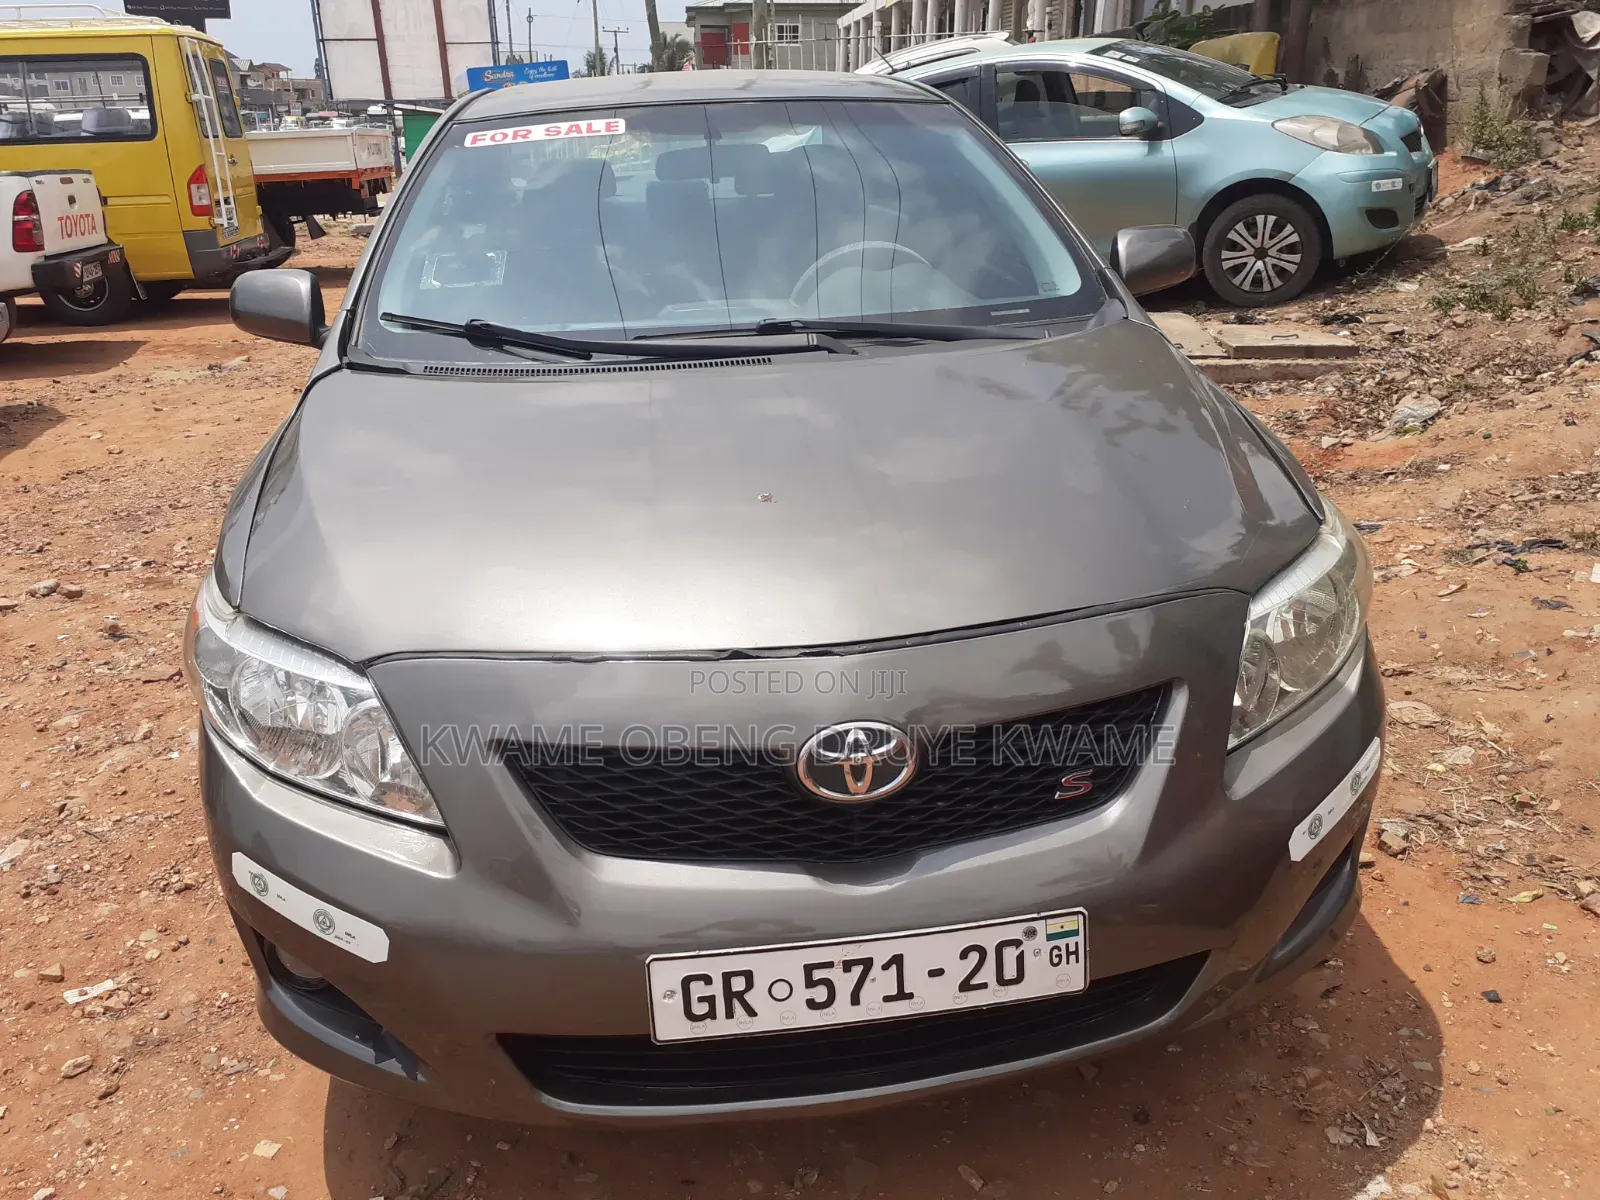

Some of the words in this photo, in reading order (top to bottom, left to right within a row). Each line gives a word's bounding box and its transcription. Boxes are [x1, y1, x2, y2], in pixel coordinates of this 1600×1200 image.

[483, 69, 515, 82] Sandra
[470, 129, 532, 145] FOR
[544, 121, 619, 137] SALE
[57, 213, 98, 240] TOYOTA
[1055, 769, 1093, 800] S
[1049, 941, 1079, 968] GH
[681, 969, 758, 1022] GR
